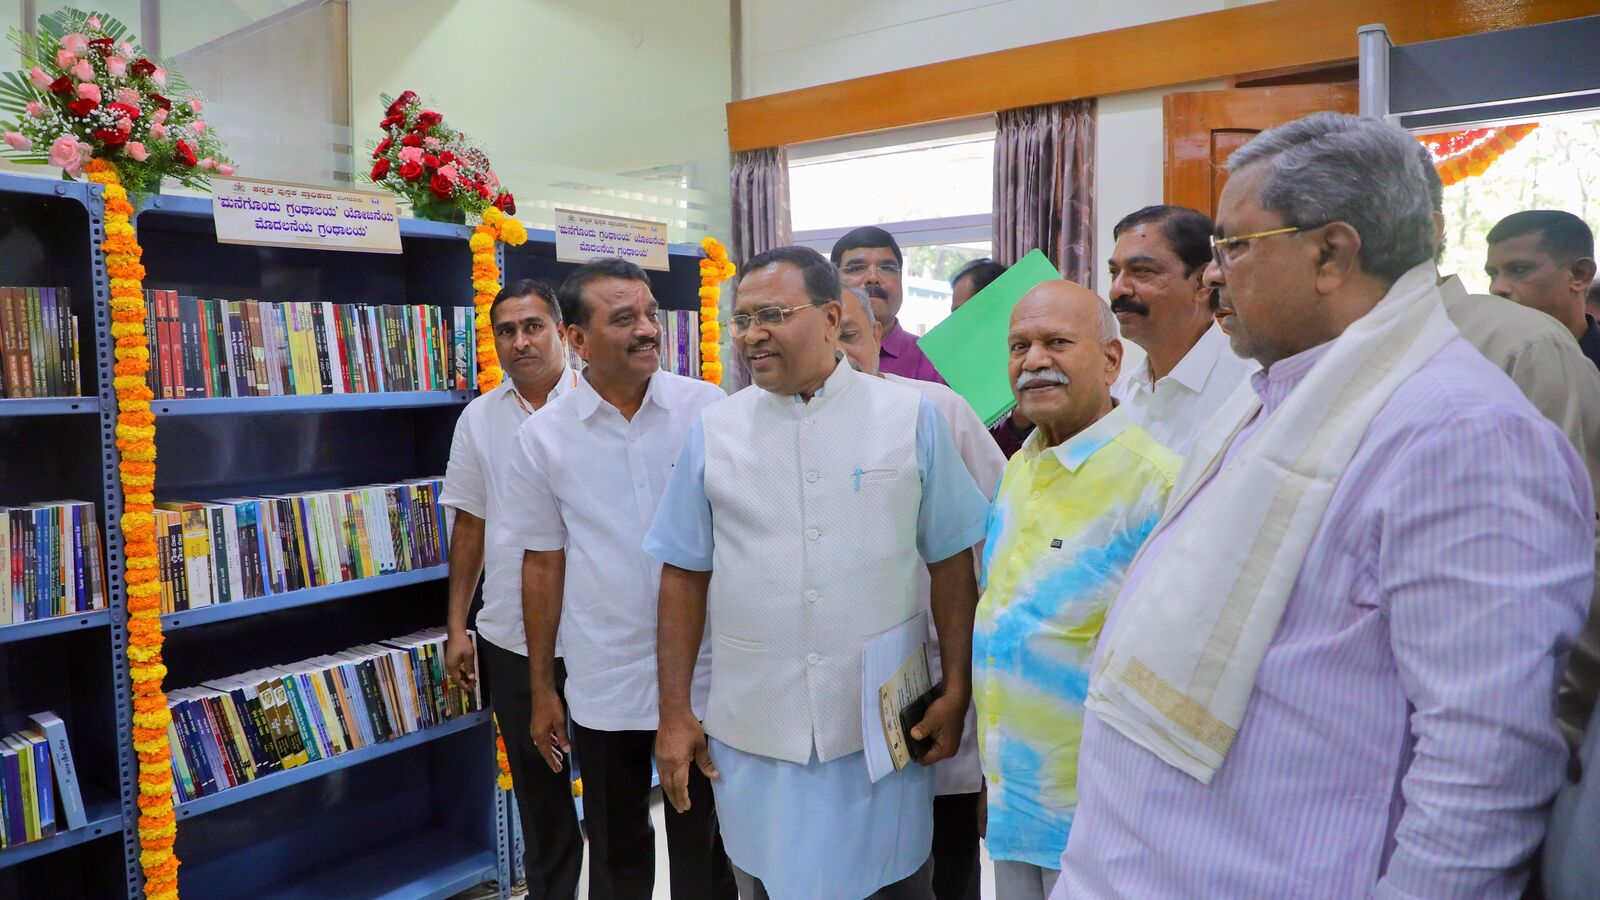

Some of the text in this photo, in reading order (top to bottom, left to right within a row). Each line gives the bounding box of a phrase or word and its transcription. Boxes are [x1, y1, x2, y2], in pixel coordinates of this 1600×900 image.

[253, 185, 274, 196] ಕನ್ನಡ
[344, 209, 394, 222] ಯೋಜನೆಯ
[255, 217, 313, 233] ಮೊದಲನೆಯ
